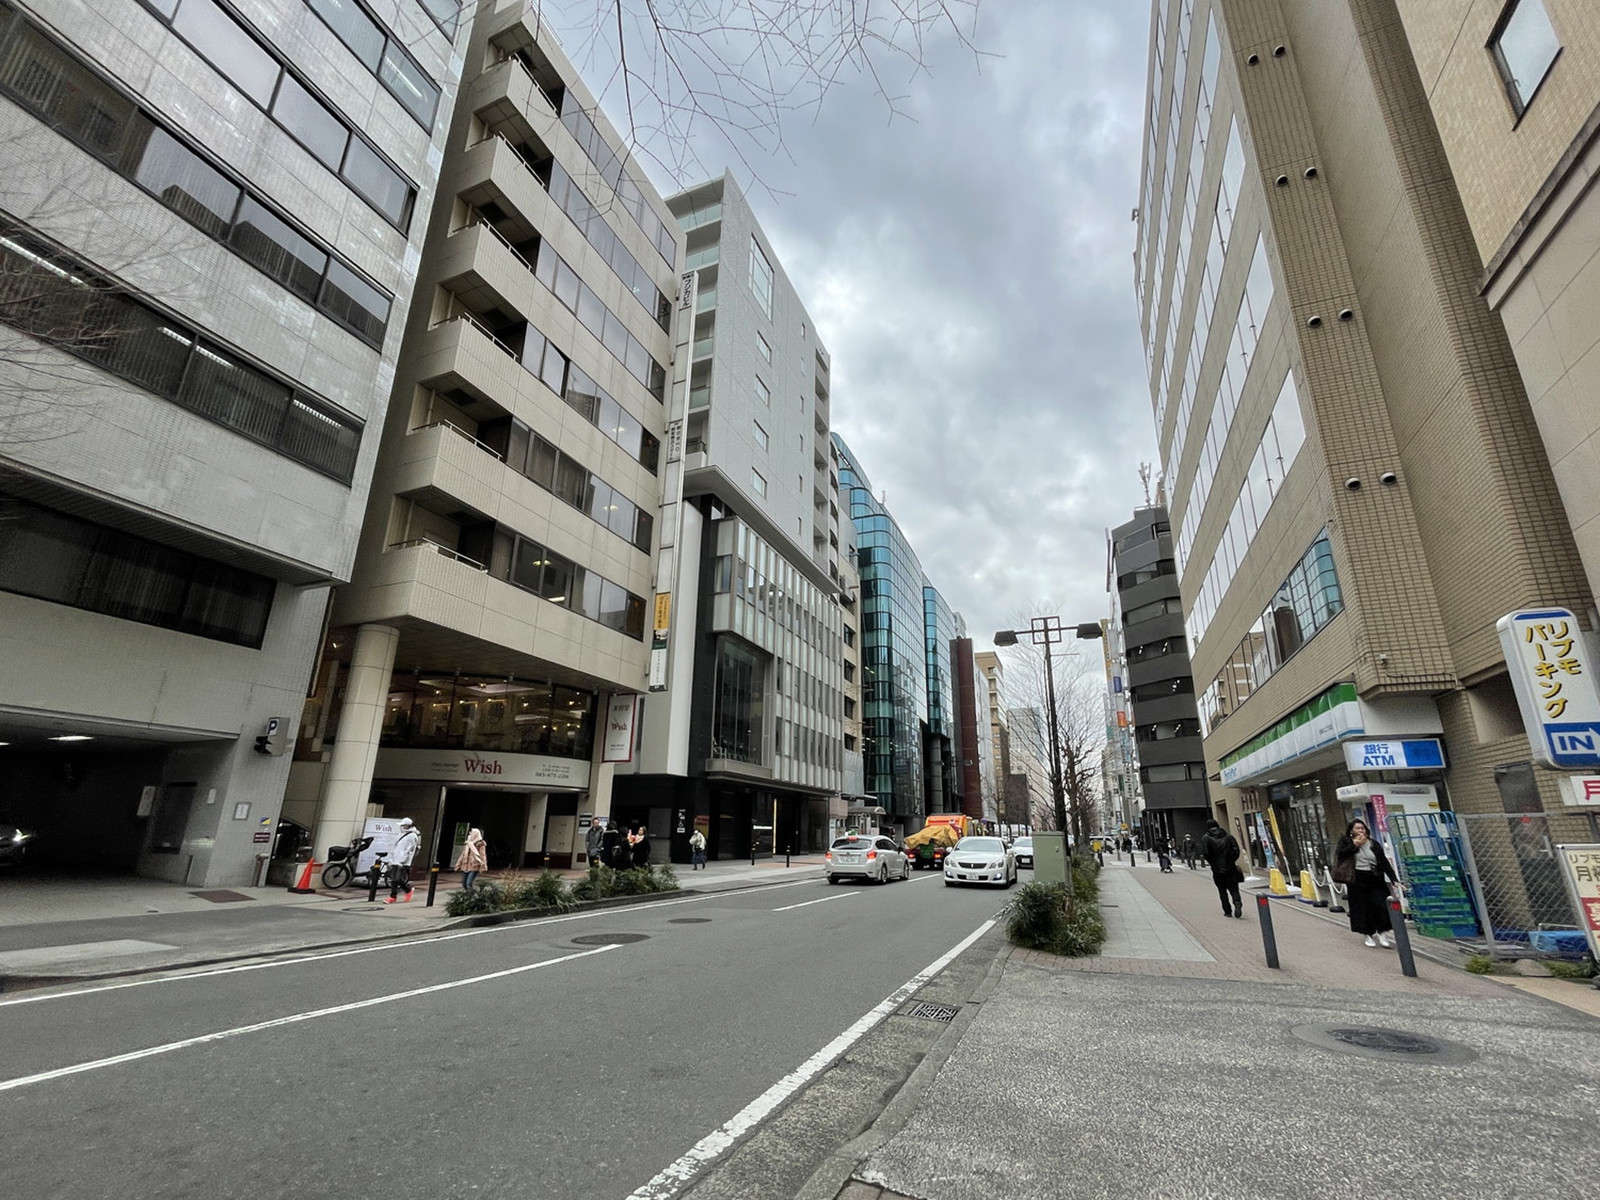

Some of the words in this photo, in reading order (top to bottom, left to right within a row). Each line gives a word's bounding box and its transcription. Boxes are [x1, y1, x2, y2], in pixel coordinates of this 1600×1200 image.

[1547, 621, 1582, 675] リブモ
[1525, 624, 1568, 719] パーキング
[268, 719, 278, 735] P
[611, 721, 628, 731] Wish
[1363, 743, 1389, 755] 銀行
[1558, 735, 1595, 751] IN
[464, 759, 502, 775] Wish
[1362, 755, 1395, 767] ATM
[375, 824, 393, 832] Wish
